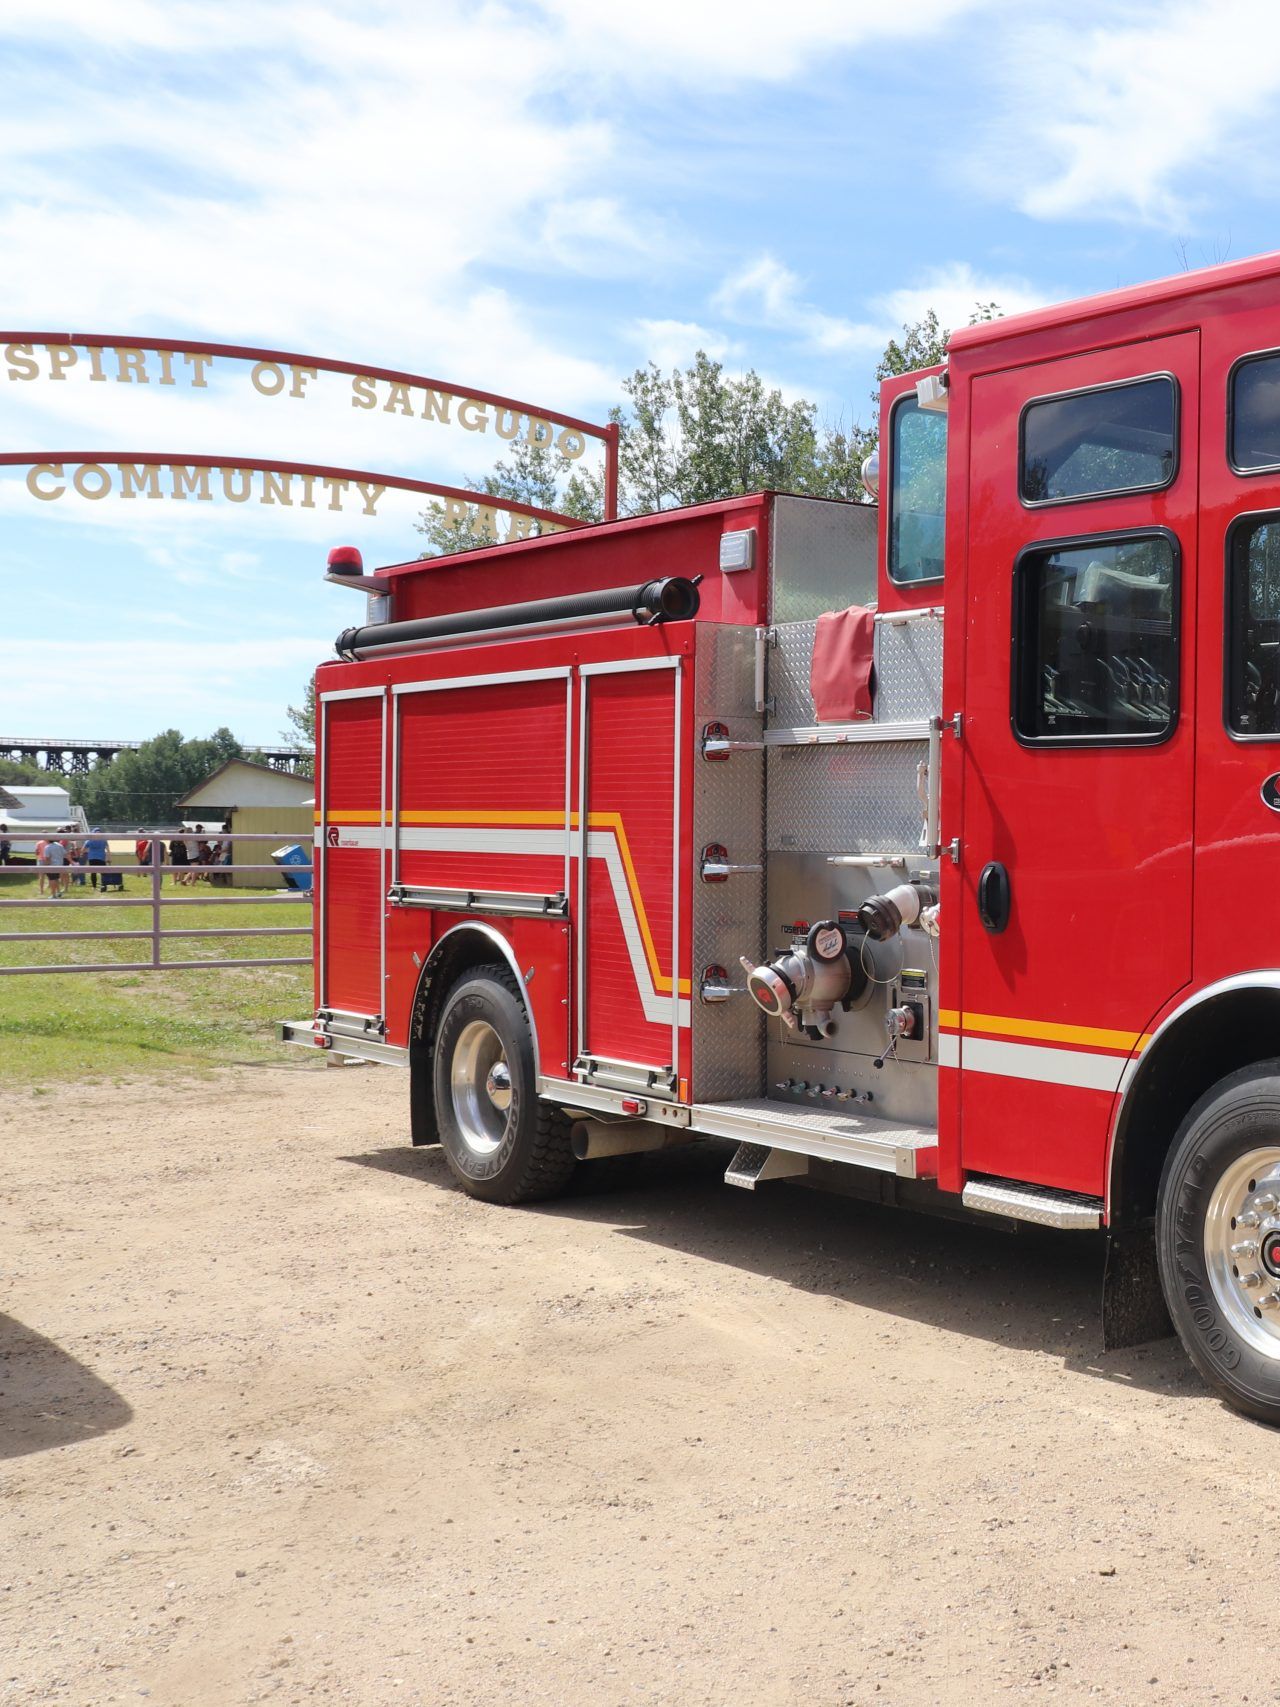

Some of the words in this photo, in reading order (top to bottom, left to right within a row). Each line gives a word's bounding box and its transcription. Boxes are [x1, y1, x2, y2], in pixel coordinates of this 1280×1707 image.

[4, 343, 212, 388] SPIRIT
[251, 361, 317, 398] OF
[351, 375, 586, 460] SANGUDO
[26, 463, 386, 517] COMMUNITY
[1175, 1153, 1242, 1370] GOODYEAR
